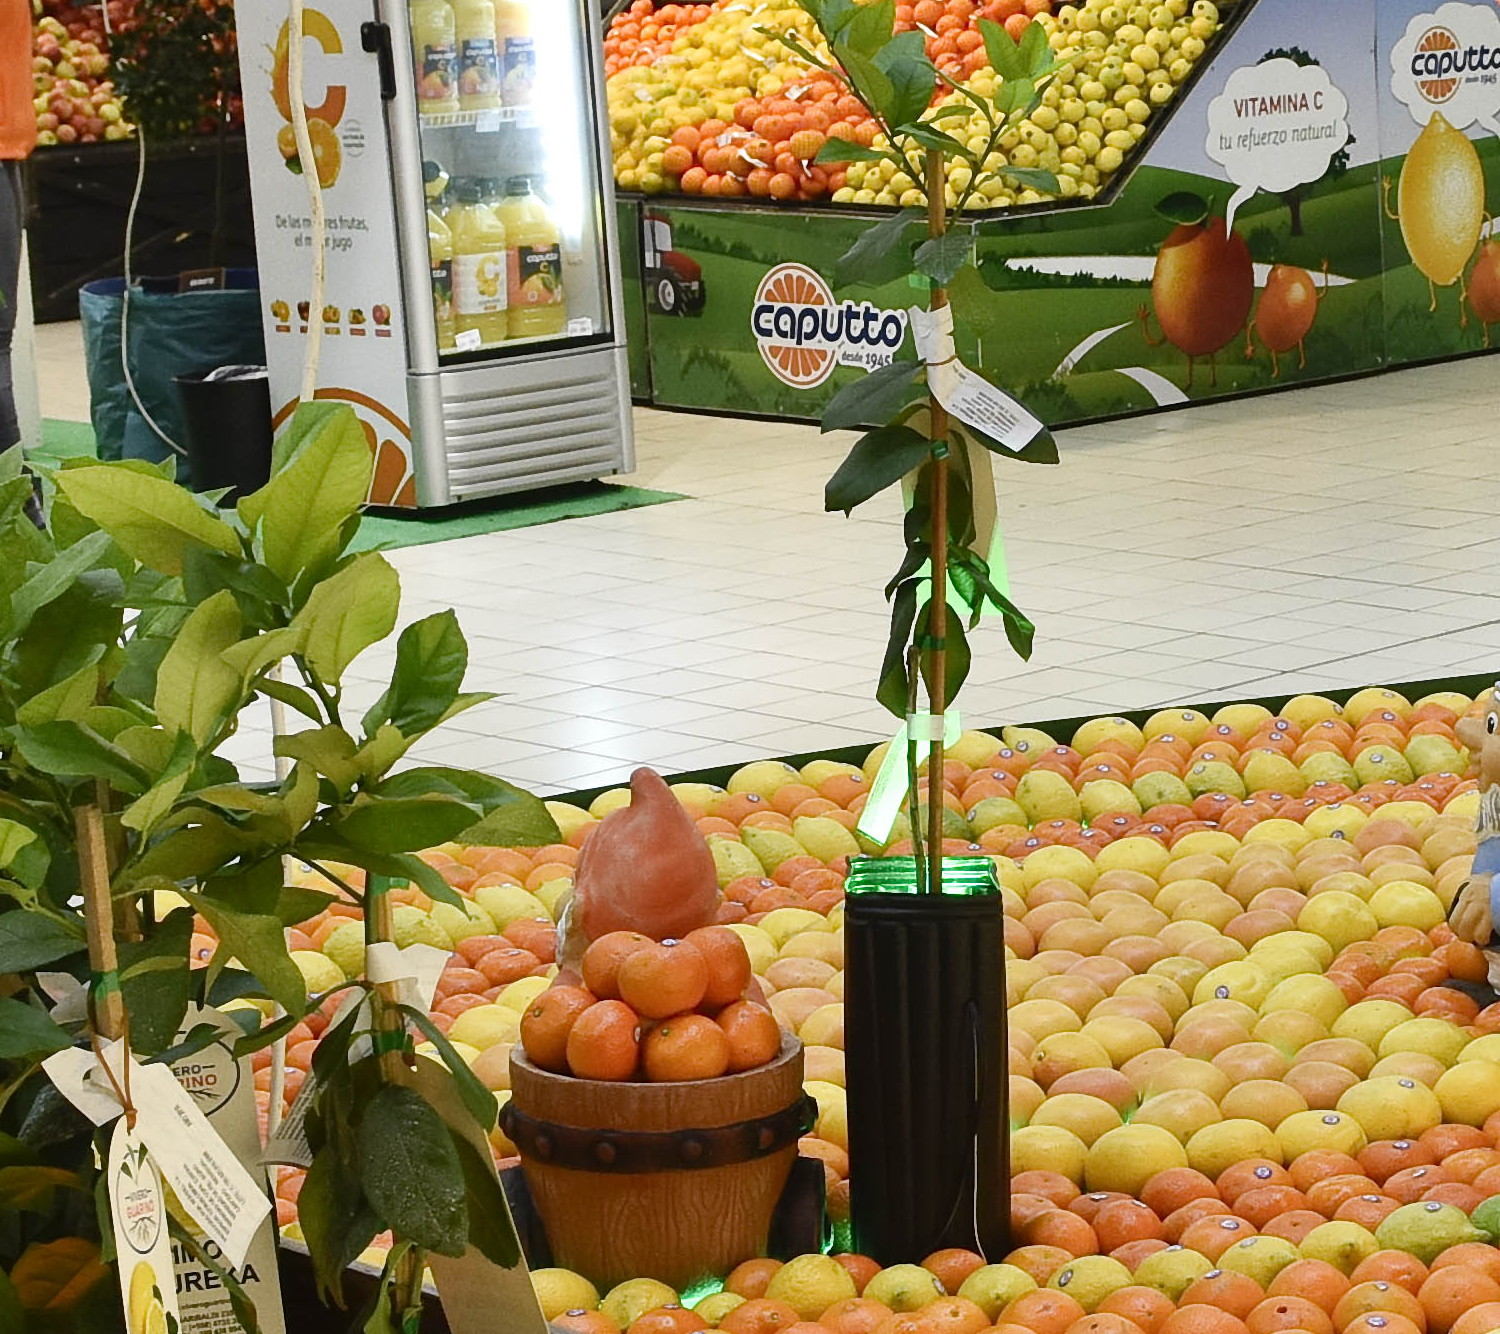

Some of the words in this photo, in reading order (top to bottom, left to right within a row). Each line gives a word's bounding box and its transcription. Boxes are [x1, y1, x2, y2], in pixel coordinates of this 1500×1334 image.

[1234, 92, 1308, 118] VITAMINA
[1313, 90, 1323, 110] C
[1218, 132, 1232, 151] tu
[1235, 123, 1287, 151] refuerzo
[1291, 119, 1337, 145] natural
[752, 302, 904, 350] caputto
[841, 351, 863, 364] desde
[865, 351, 892, 368] 1945
